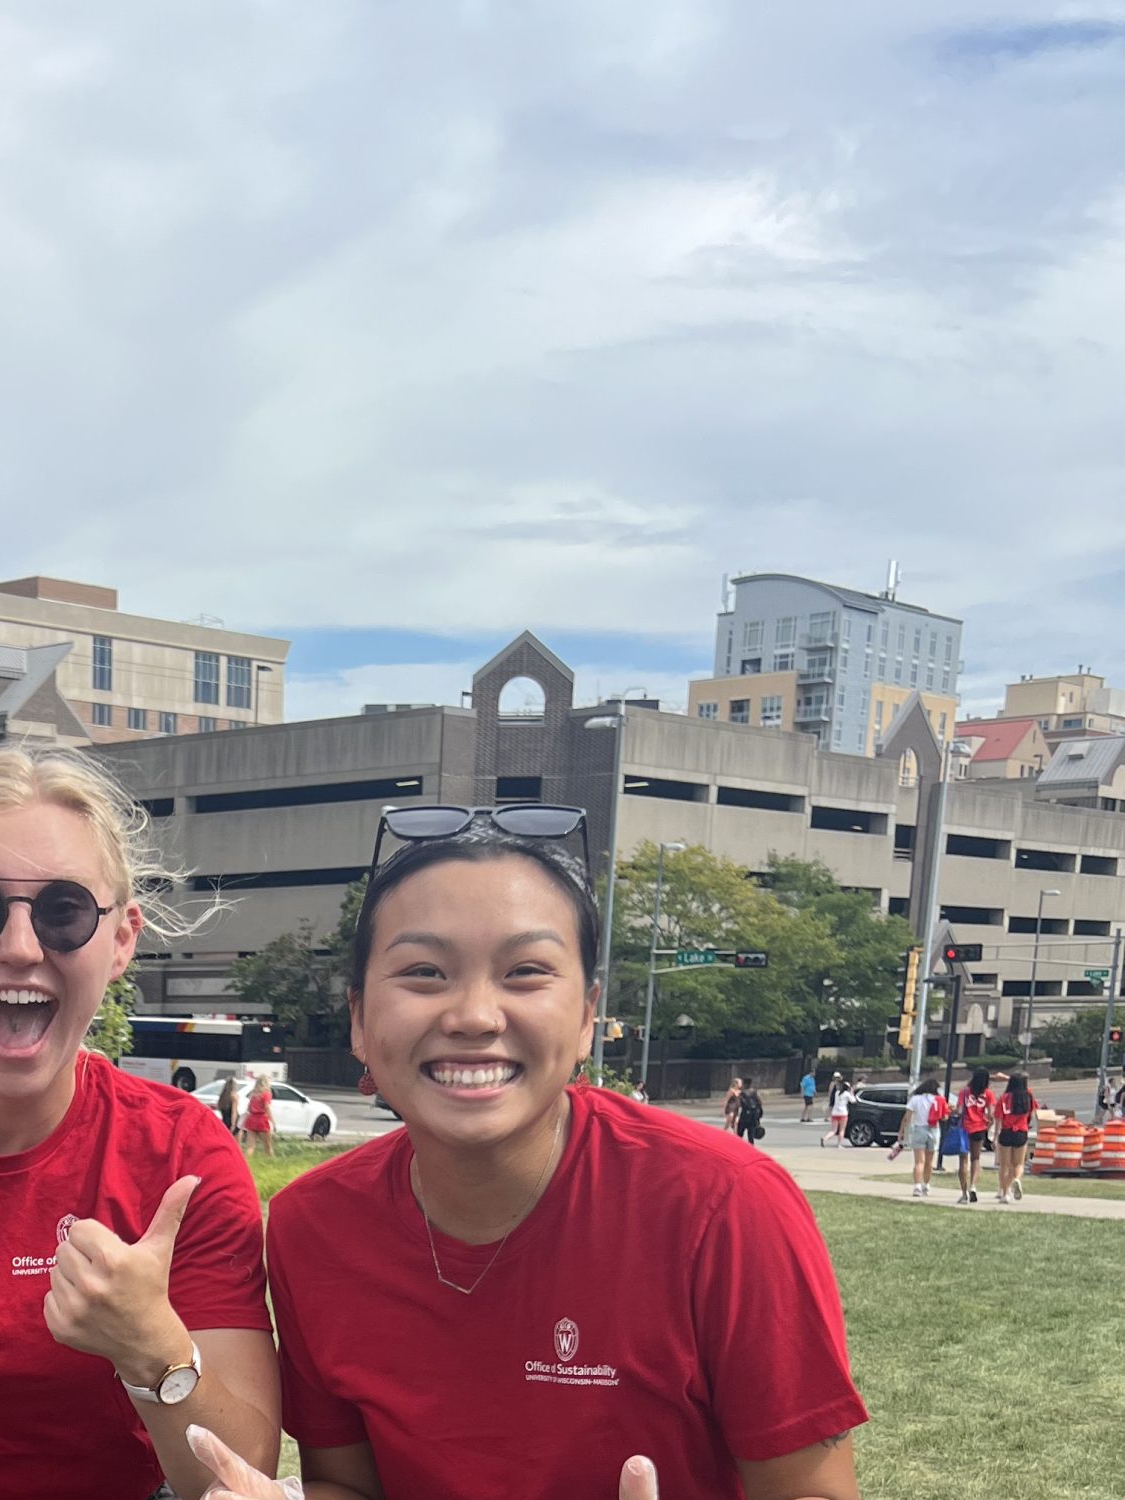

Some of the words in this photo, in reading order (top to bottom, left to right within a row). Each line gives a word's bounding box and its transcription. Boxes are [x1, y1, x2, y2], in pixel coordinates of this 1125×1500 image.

[12, 1256, 44, 1267] Office
[46, 1255, 57, 1265] of
[12, 1267, 47, 1275] UNIVERSITY
[525, 1360, 550, 1373] Office
